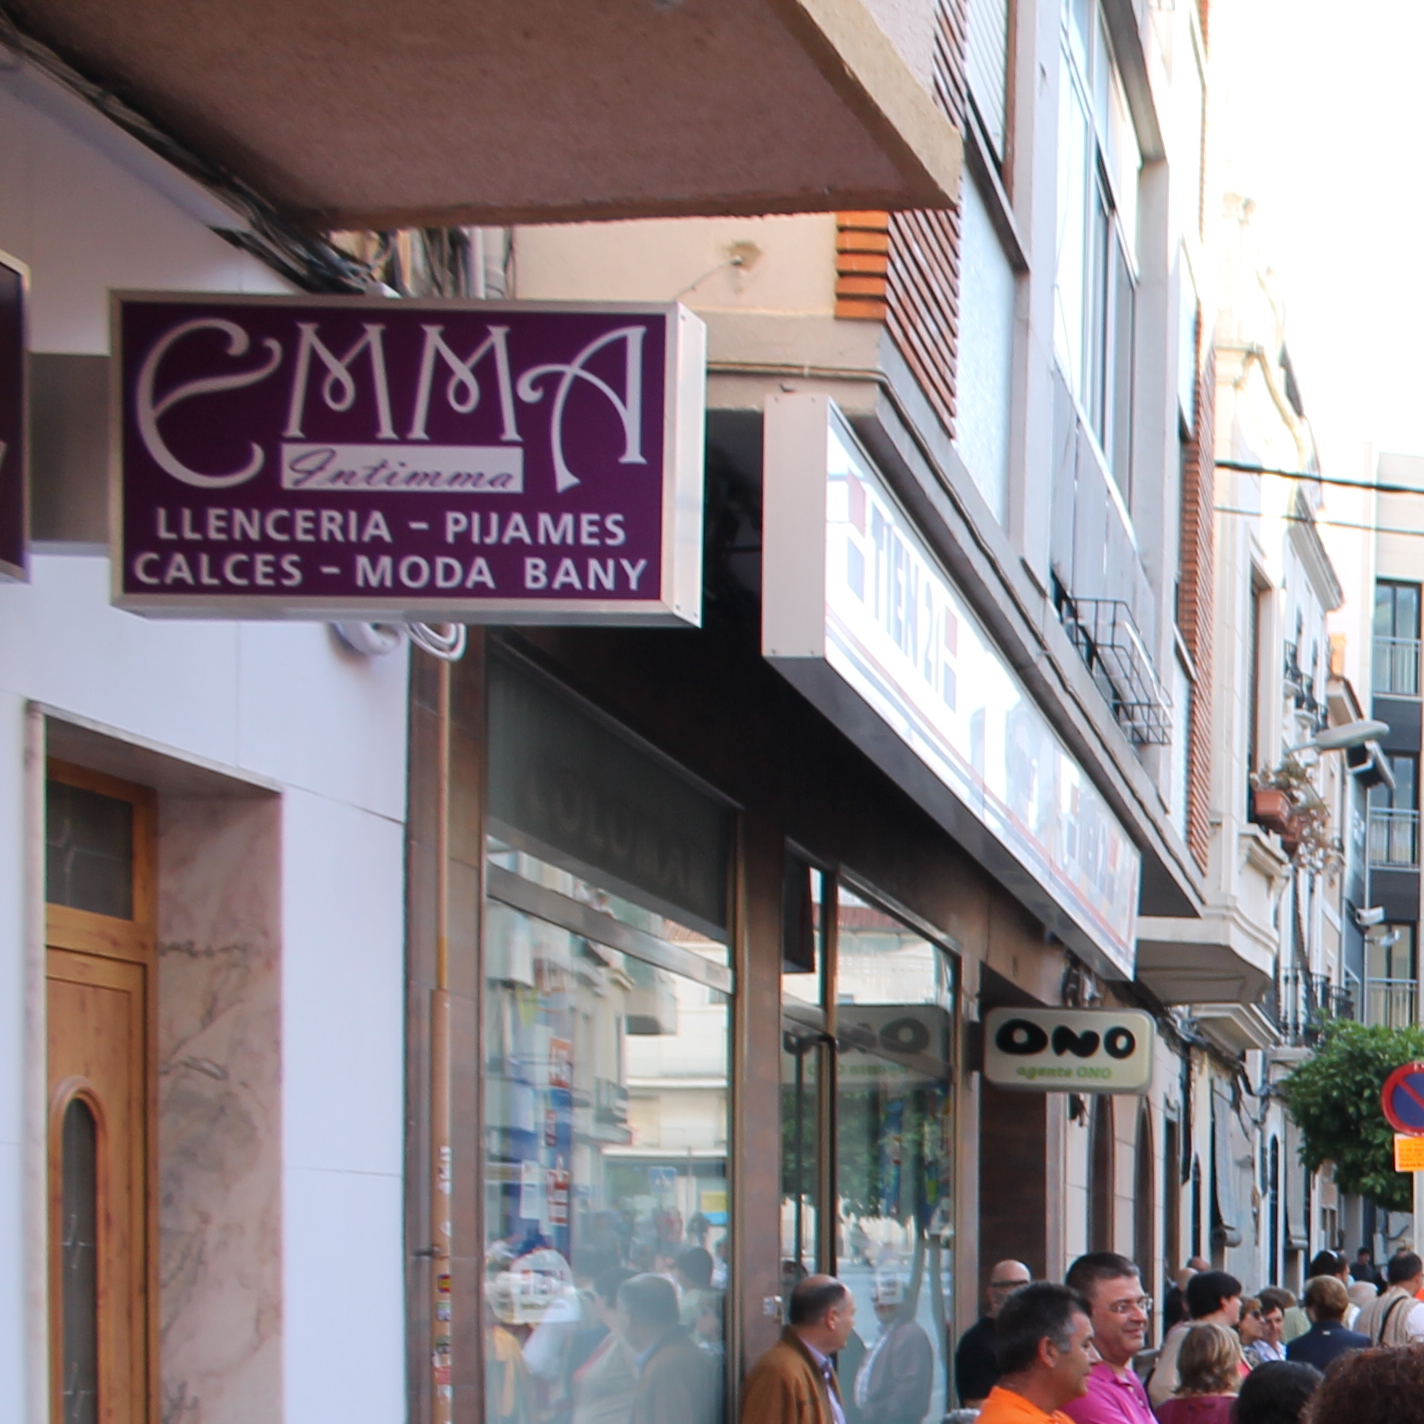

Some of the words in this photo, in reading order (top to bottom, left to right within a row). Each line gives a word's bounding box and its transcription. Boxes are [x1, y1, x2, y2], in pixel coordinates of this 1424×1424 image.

[288, 447, 514, 489] Intimma
[155, 507, 393, 543] LLENCERIA
[445, 511, 626, 546] PIJAMES
[134, 551, 303, 585] CALCES
[355, 556, 496, 590] MODA
[524, 558, 648, 592] BANY
[871, 500, 919, 670] TIEN
[995, 1018, 1136, 1059] ONO
[1017, 1066, 1073, 1080] agente
[1076, 1067, 1113, 1079] ONO
